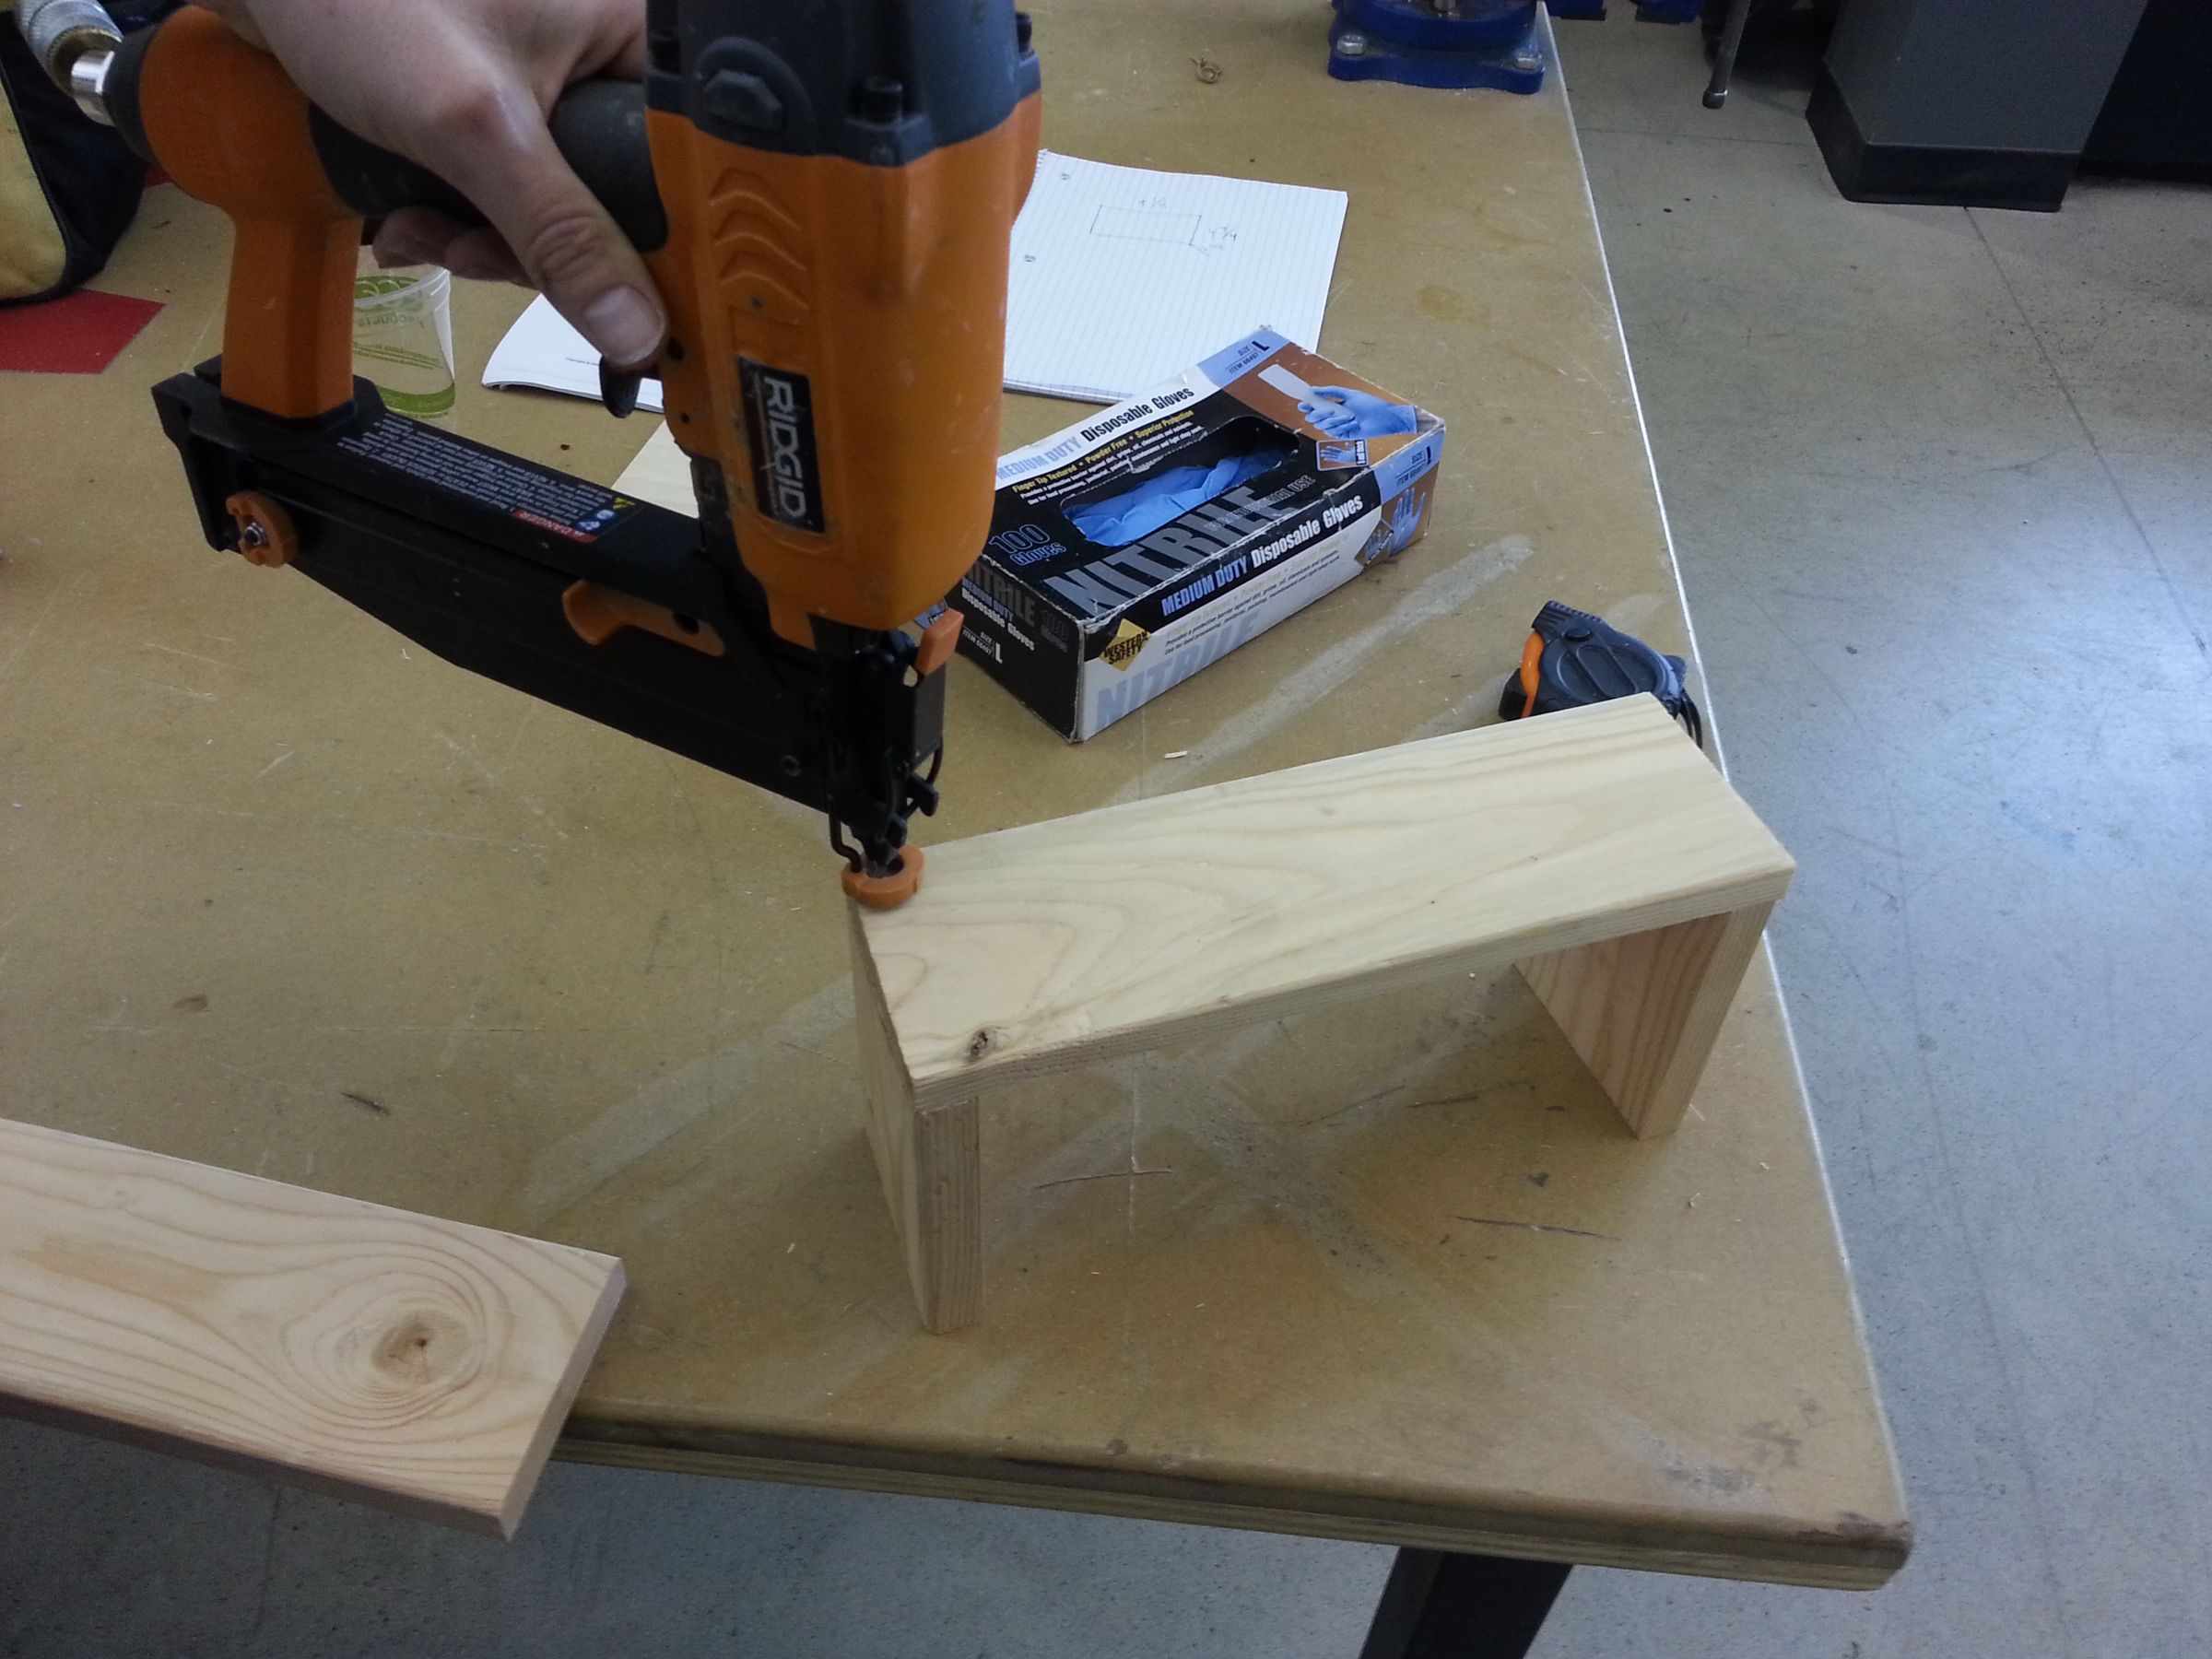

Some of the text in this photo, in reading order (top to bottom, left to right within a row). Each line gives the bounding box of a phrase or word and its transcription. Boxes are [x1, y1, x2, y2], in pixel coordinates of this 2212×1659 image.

[1252, 340, 1270, 352] L
[763, 376, 806, 518] RIDGID
[996, 388, 1194, 480] MEDIUM DUTY Disposable Gloves
[1012, 410, 1194, 493] Finger Tip Textured Powder Free Superior Protection
[988, 524, 1051, 554] 100
[1010, 542, 1067, 566] Gloves
[1043, 487, 1298, 618] NITRILE
[1161, 575, 1215, 617] MEDIUM
[1216, 555, 1248, 588] DUTY
[1251, 520, 1321, 569] Disposable
[1323, 495, 1363, 528] Gloves
[962, 587, 1035, 651] Disposable Gloves
[994, 600, 1015, 623] DUTY
[995, 642, 1003, 664] L
[1104, 630, 1149, 659] WESTERN
[1109, 646, 1143, 665] SAFETY
[1093, 609, 1259, 735] NITRILE
